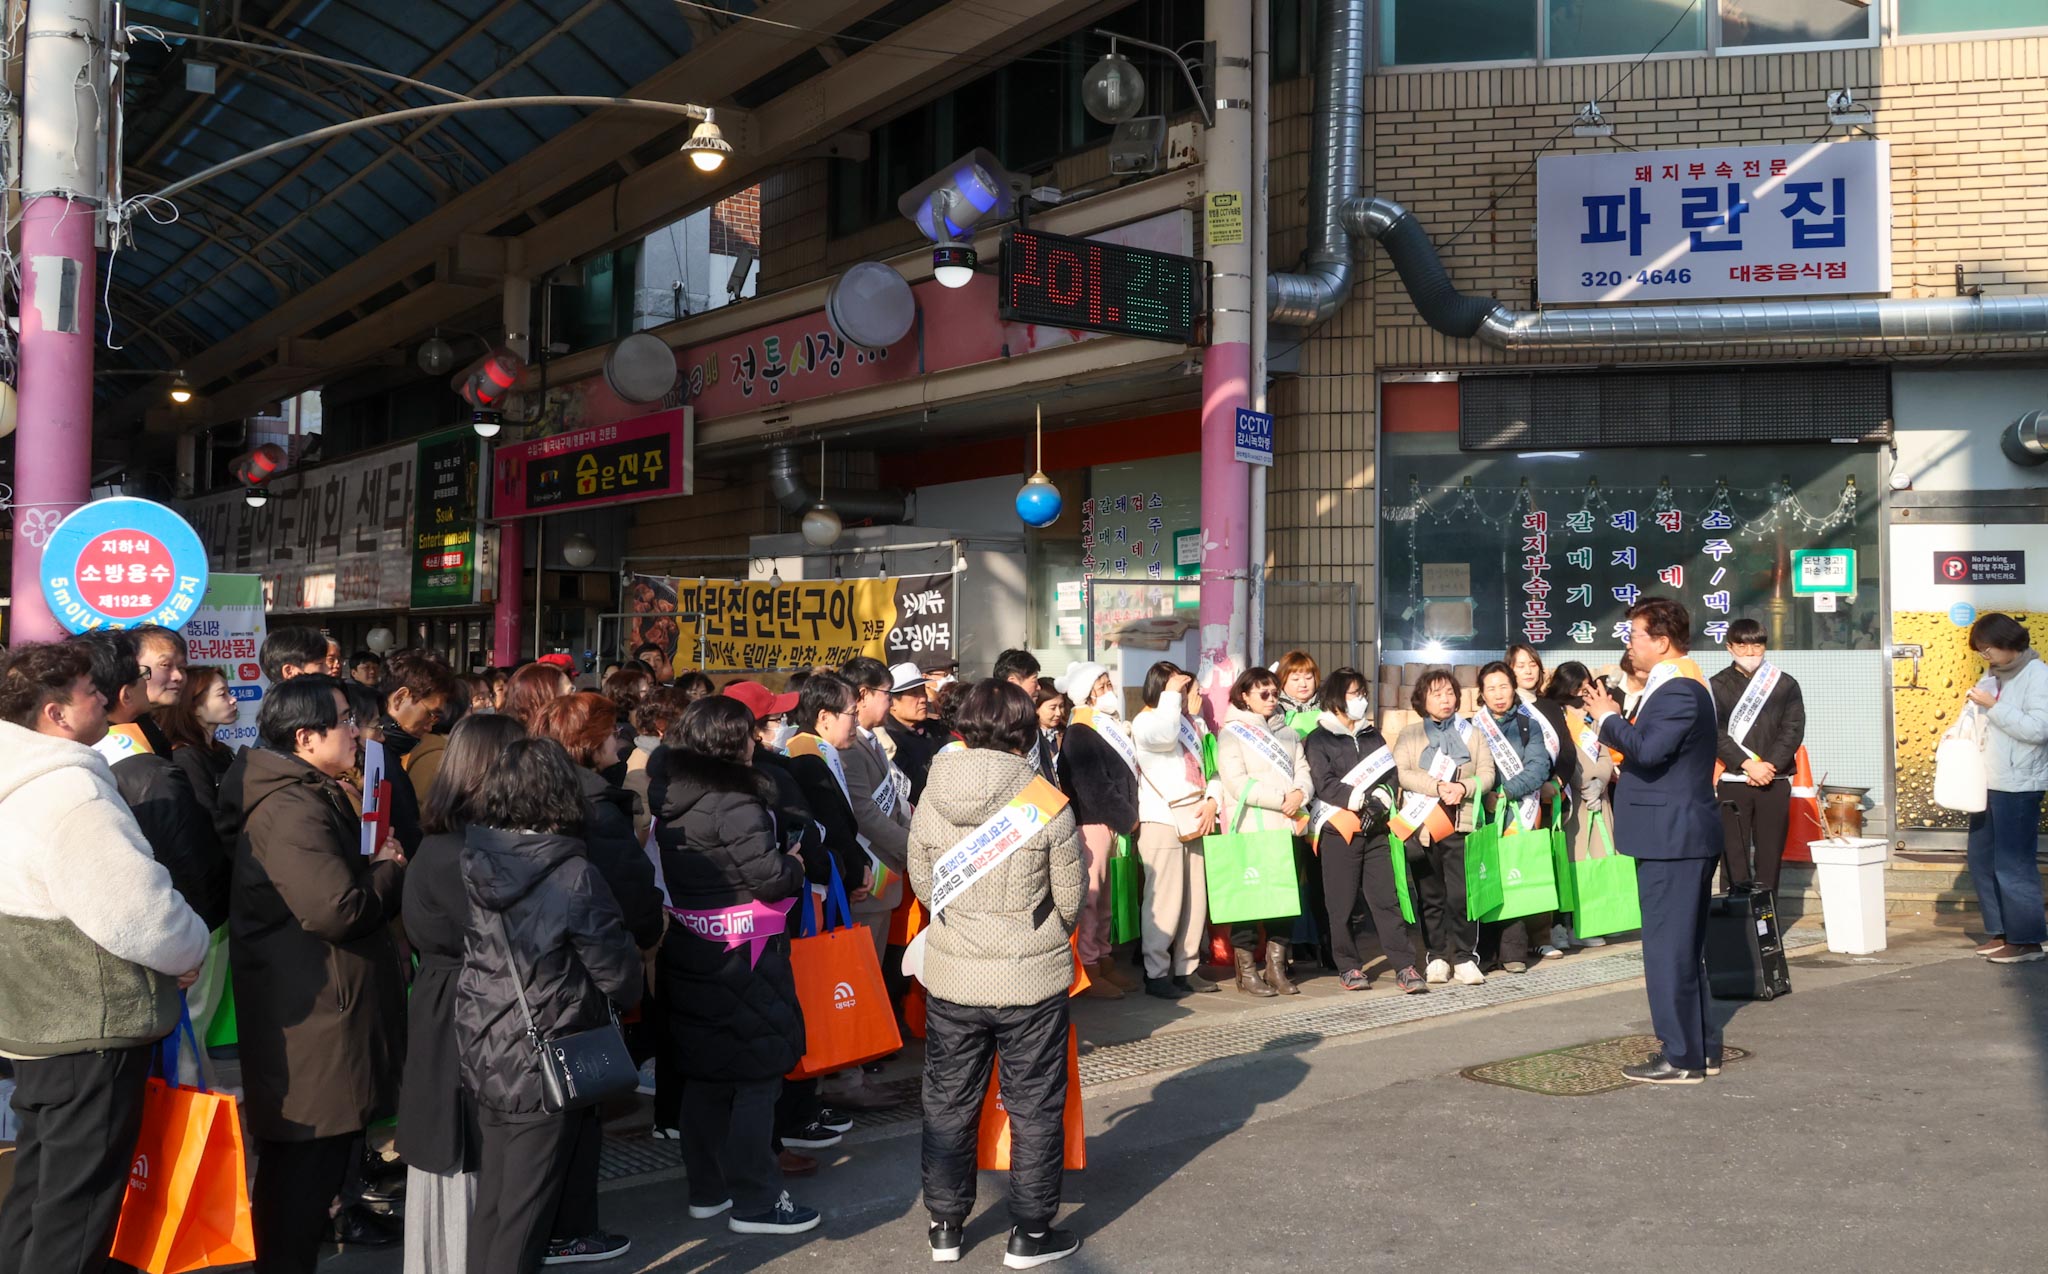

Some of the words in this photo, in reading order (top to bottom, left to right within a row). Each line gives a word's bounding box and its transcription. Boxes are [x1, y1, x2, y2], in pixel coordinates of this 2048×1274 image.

[1635, 159, 1788, 182] 돼지부속전문
[1580, 177, 1846, 256] 파란집
[1729, 261, 1848, 283] 대중음식점
[731, 331, 845, 397] 전통시장
[1239, 414, 1270, 435] CCTV
[1237, 432, 1271, 451] 감시녹화중
[575, 449, 664, 496] 숨은진주
[355, 460, 413, 554] 센타
[435, 505, 455, 524] Ssuk
[101, 540, 150, 554] 지하식
[418, 527, 471, 550] Entertainment
[1804, 557, 1820, 565] 도난
[1804, 567, 1820, 575] 파손
[1982, 556, 2008, 564] Parking
[1991, 563, 2016, 571] 주차금지
[80, 563, 171, 584] 소방용수
[1522, 510, 1551, 643] 돼지부속모듬
[1566, 510, 1596, 643] 갈매기살
[1702, 510, 1732, 643] 소주/맥주
[98, 594, 153, 608] 제192호
[862, 619, 885, 641] 전문
[889, 621, 951, 652] 오징어국
[188, 639, 256, 660] 온누리상품권
[966, 815, 1013, 857] 지역물가
[962, 828, 1023, 878] 전통시장을
[938, 852, 968, 880] 안정에
